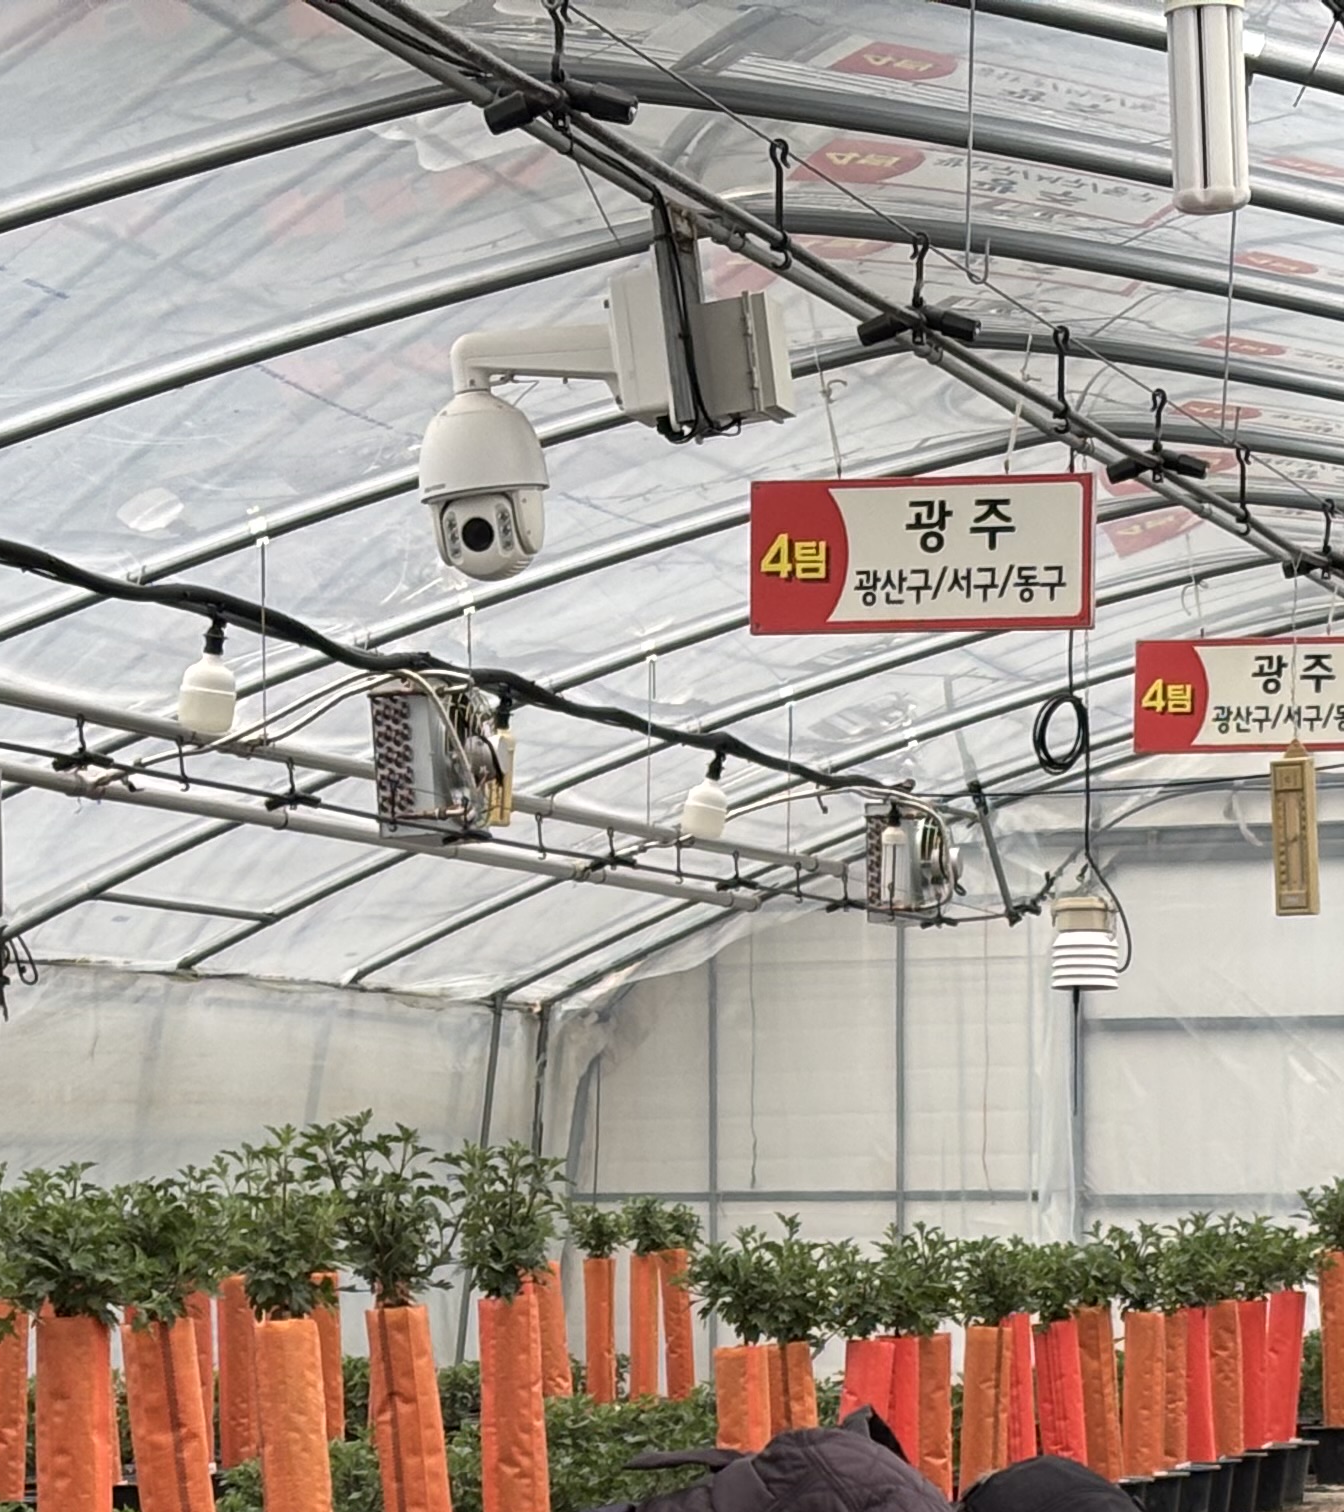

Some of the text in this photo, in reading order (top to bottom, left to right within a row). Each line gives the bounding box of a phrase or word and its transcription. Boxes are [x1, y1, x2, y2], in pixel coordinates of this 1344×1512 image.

[759, 532, 827, 579] 4팀
[854, 564, 1067, 607] 광산구/서구/동구
[1141, 678, 1195, 713] 4팀
